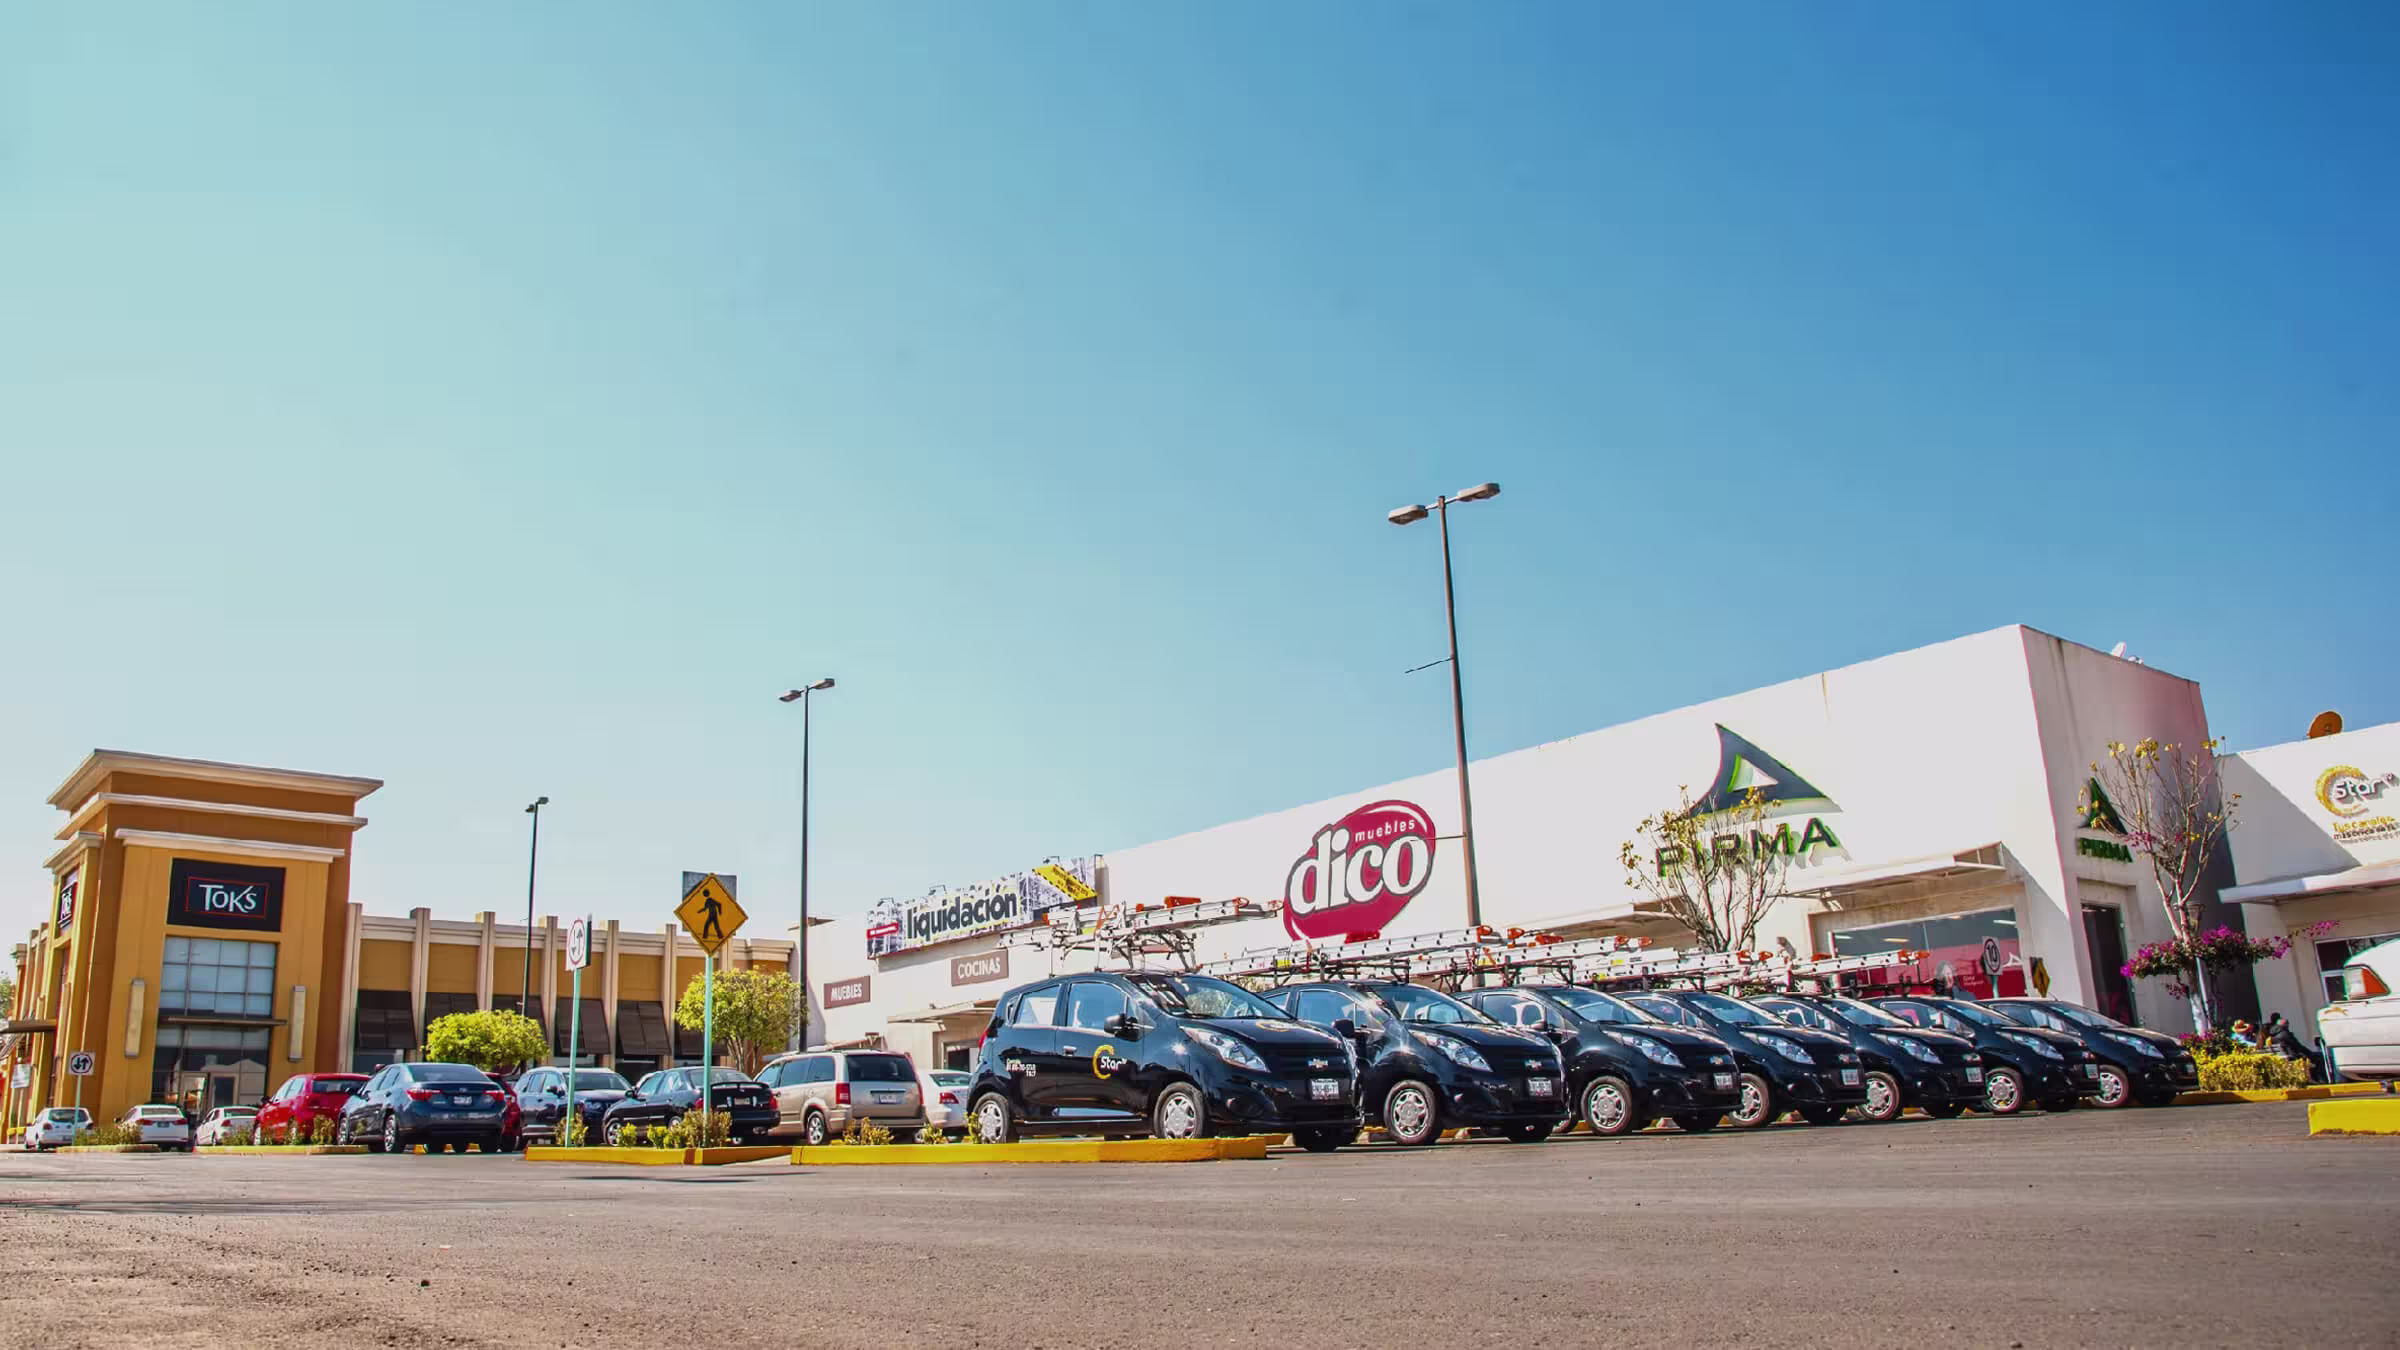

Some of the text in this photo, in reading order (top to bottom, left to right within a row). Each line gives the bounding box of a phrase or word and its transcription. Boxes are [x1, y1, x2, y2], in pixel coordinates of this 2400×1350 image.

[2334, 777, 2384, 802] Star
[1354, 819, 1416, 843] muebles
[1289, 828, 1429, 915] dico
[907, 886, 1016, 942] liquidación
[957, 957, 1001, 979] COCINAS
[831, 983, 863, 1001] MUEBLES
[1100, 1056, 1121, 1071] Star
